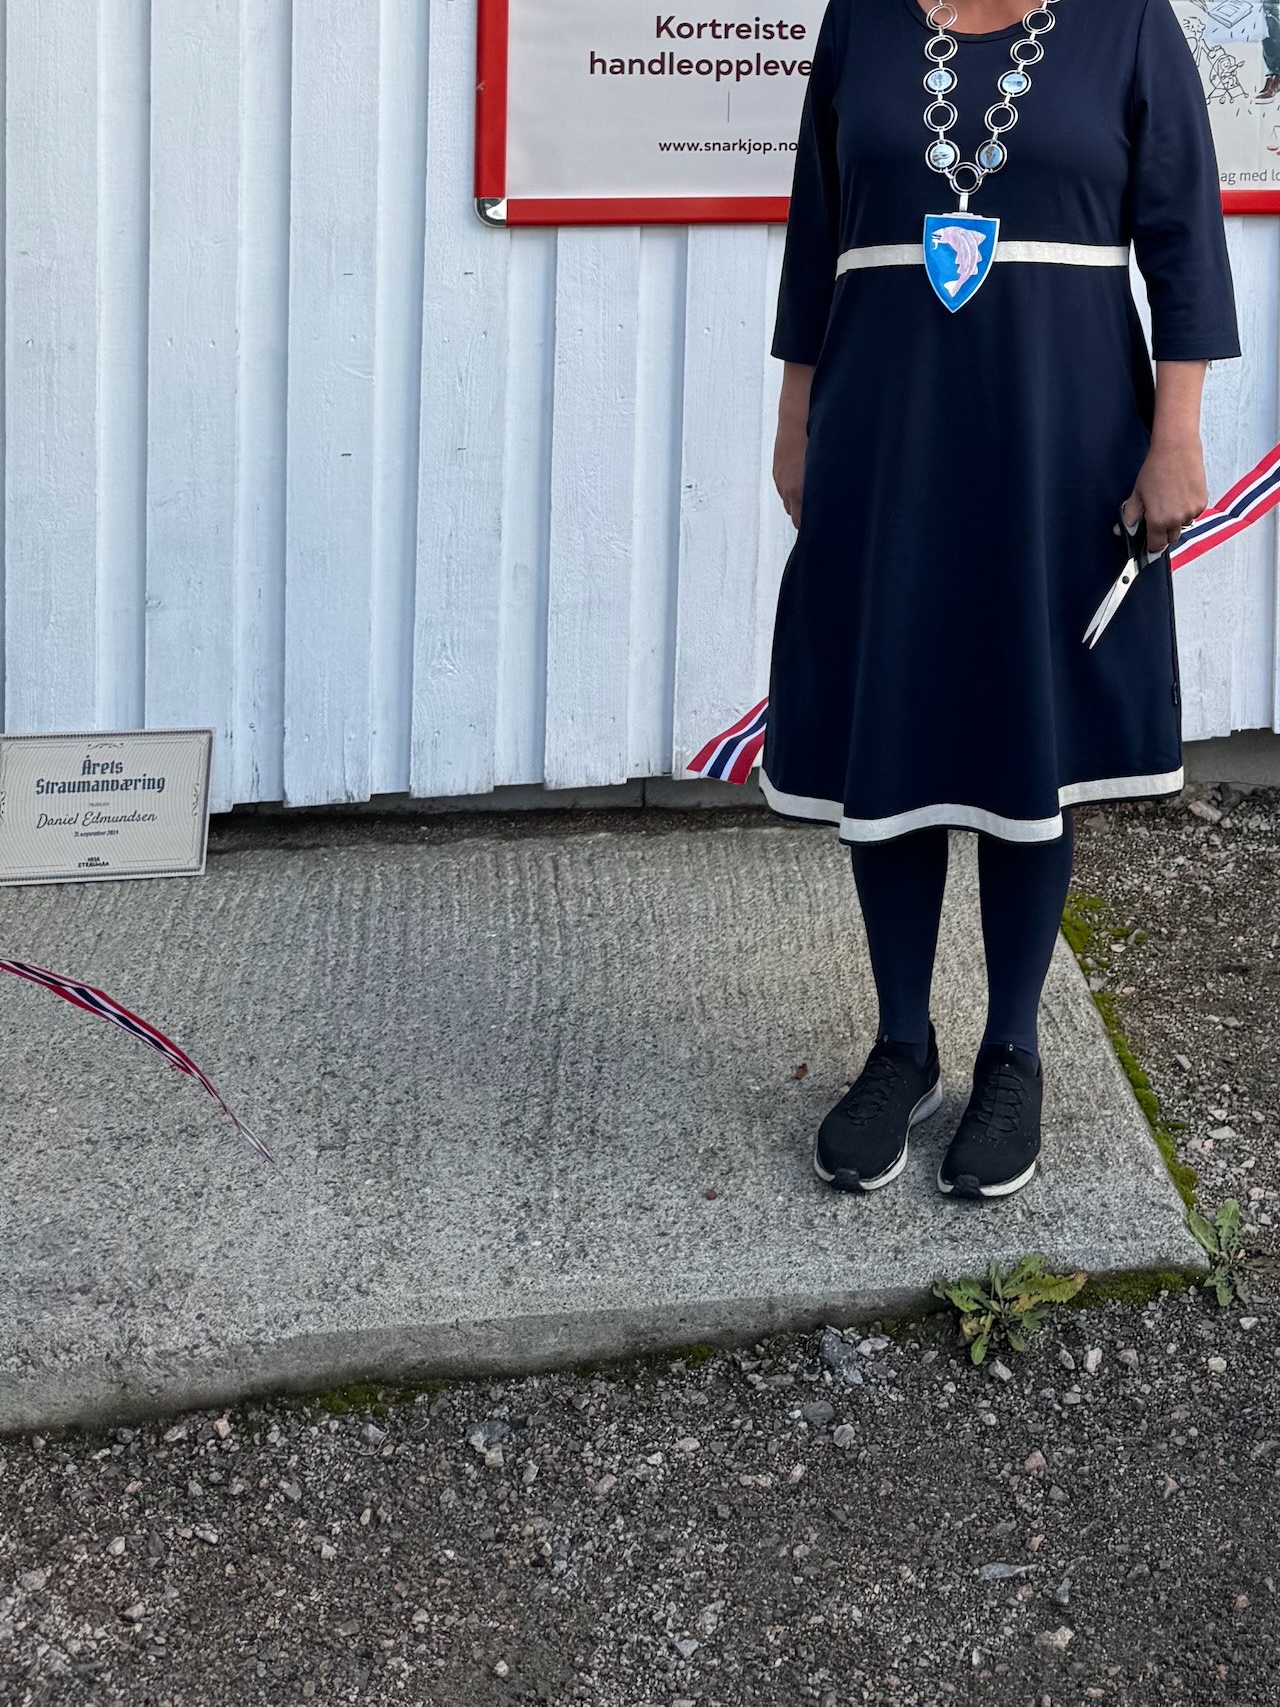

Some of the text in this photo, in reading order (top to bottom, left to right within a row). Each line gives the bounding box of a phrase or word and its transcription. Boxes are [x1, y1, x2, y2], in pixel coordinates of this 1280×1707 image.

[655, 15, 807, 41] Kortreiste
[589, 51, 812, 83] handleoppleve
[658, 138, 799, 155] www.snarkjop.no
[1220, 171, 1237, 186] ag
[1239, 169, 1268, 182] med
[36, 810, 158, 829] Daniel Edmundsen
